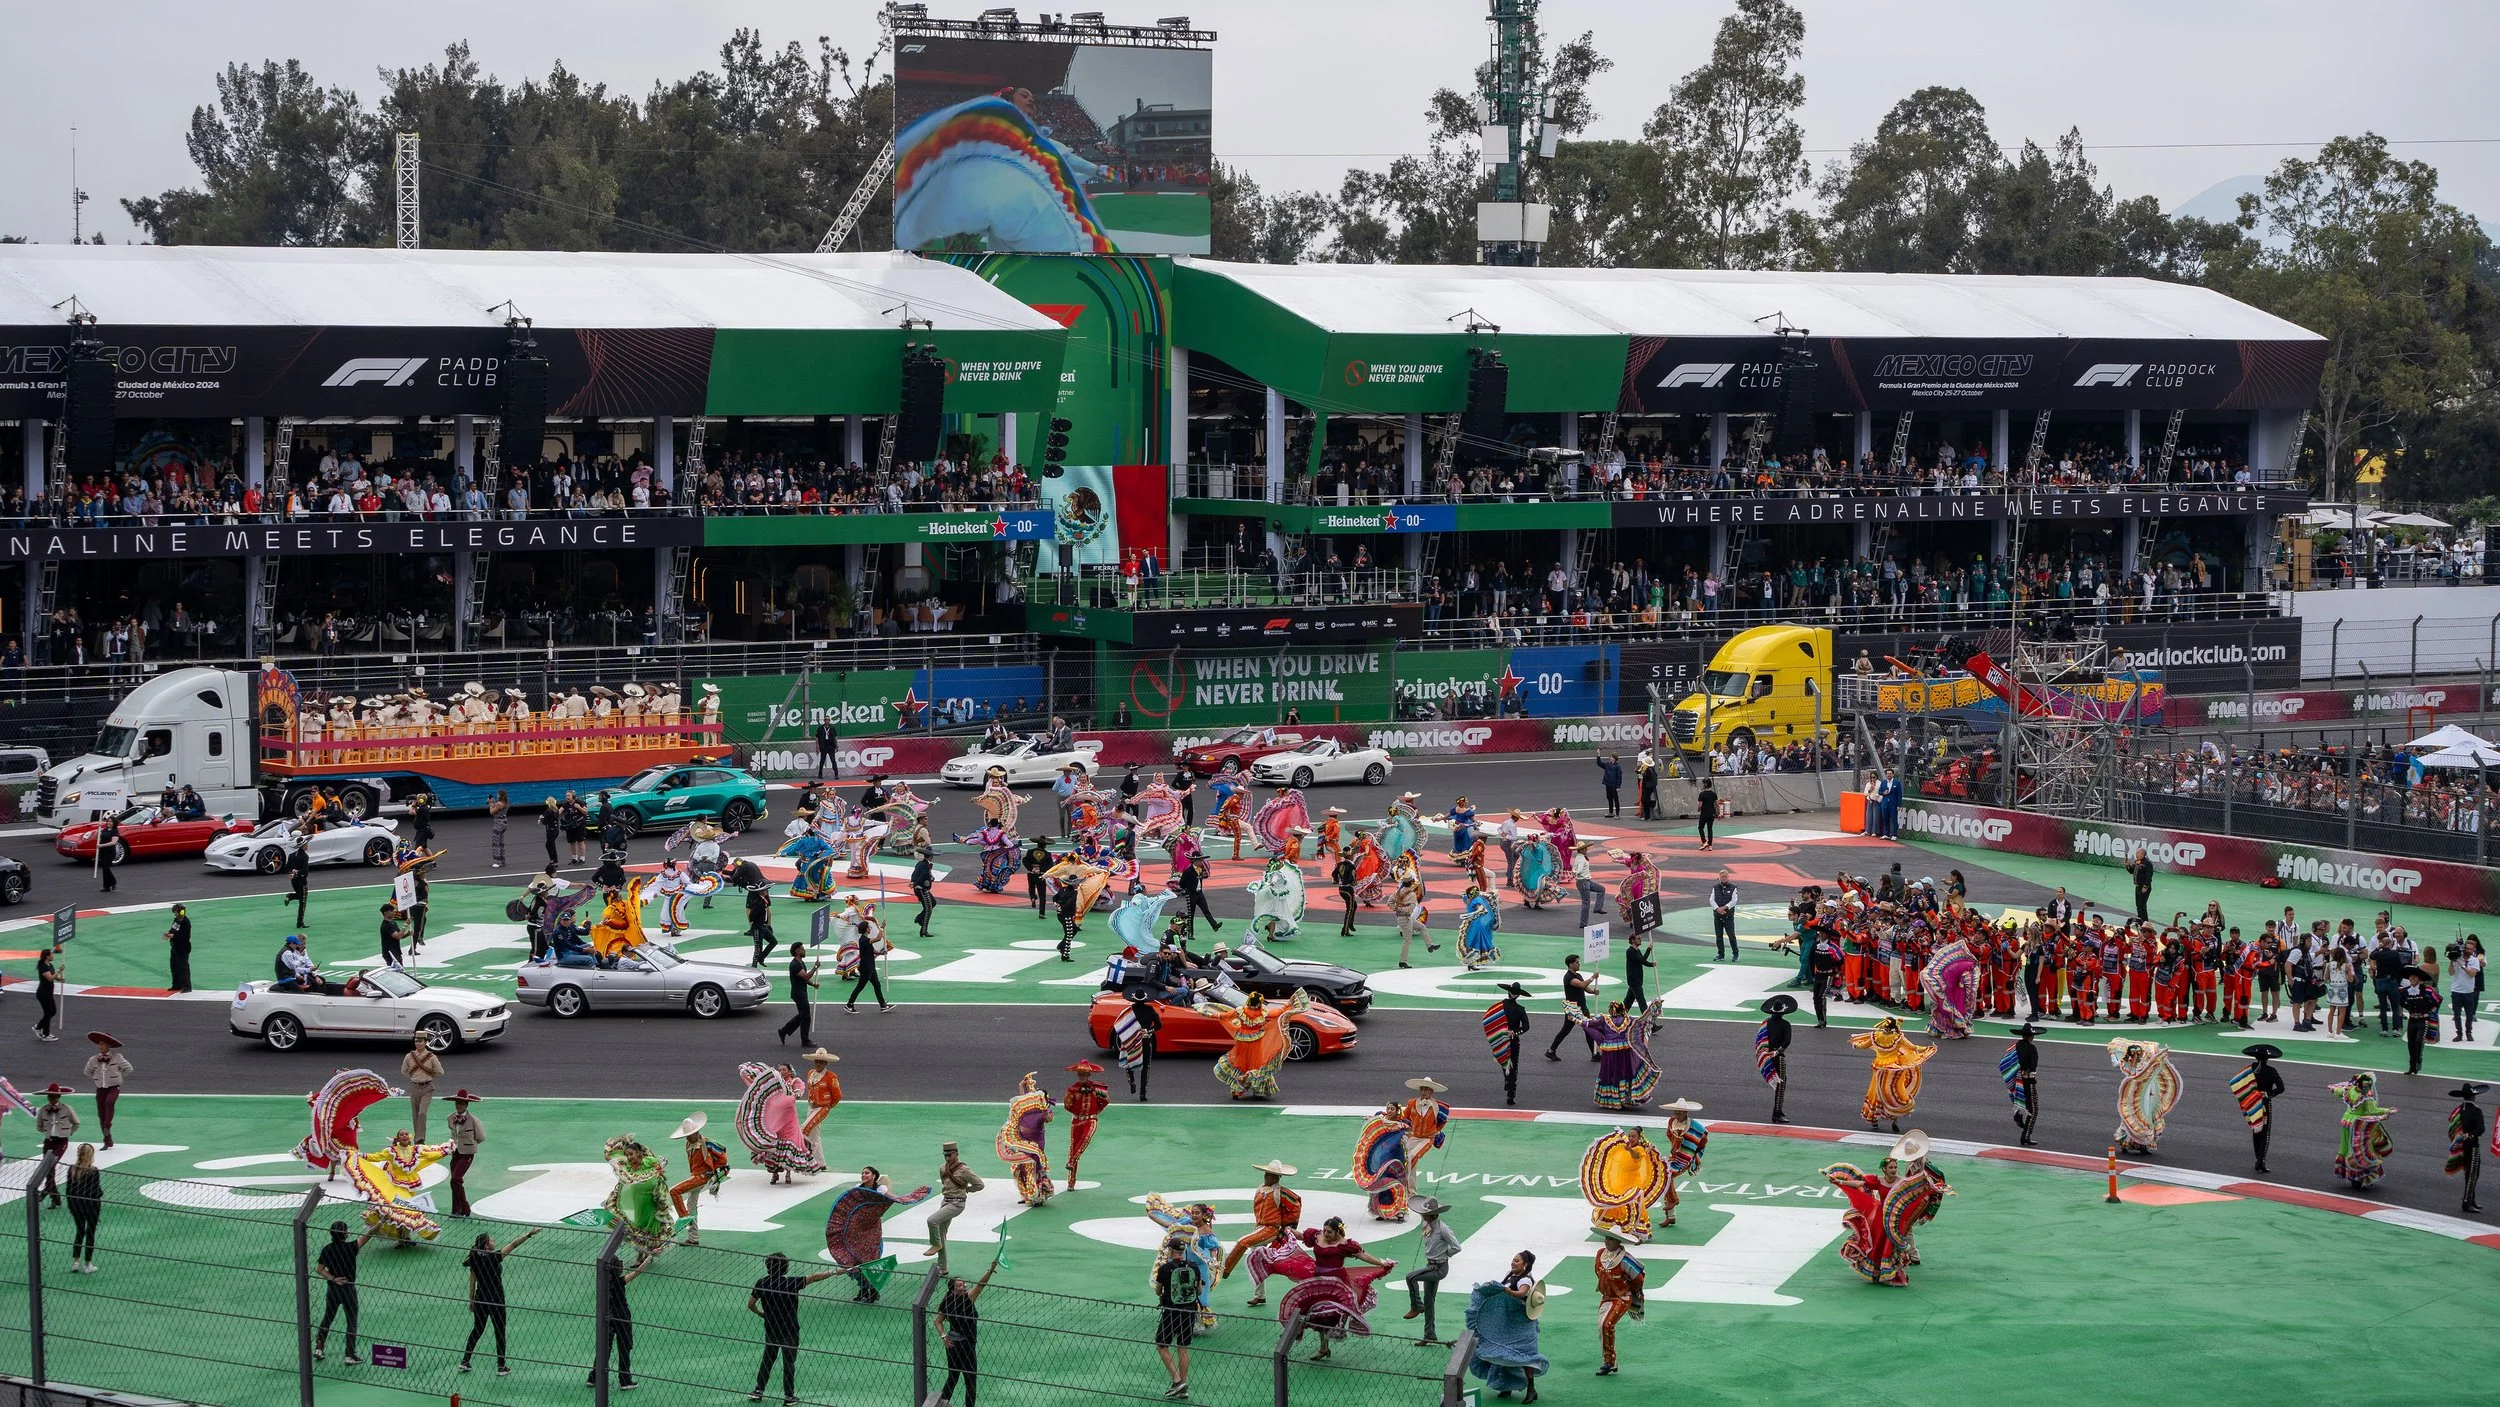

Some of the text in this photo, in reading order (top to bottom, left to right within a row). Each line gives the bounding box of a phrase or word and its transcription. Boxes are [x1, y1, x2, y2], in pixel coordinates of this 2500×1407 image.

[0, 346, 237, 374] MEXCO CITY
[439, 358, 499, 370] PADD
[961, 360, 1042, 372] WHEN YOU DRIVE
[1873, 355, 2033, 376] MEXICO CITY
[1370, 364, 1443, 374] WHEN YOU DRIVE
[1741, 363, 1783, 374] PADD
[2148, 364, 2216, 375] PADDOCK
[438, 374, 497, 386] CLUB
[959, 371, 1022, 382] NEVER DRINK
[1368, 374, 1425, 383] NEVER DRINK
[1740, 376, 1782, 387] CLUB
[2146, 376, 2184, 387] CLUB
[117, 380, 220, 389] Ciudad de México 2024
[1983, 381, 2003, 389] México
[1658, 495, 2266, 523] WHERE ADRENALINE MEETS ELEGANCE
[928, 522, 985, 536] Heineken
[1327, 515, 1380, 529] Heineken
[11, 525, 636, 556] NALINE MEETS ELEGANCE
[2125, 644, 2286, 667] paddockclub.com
[1195, 652, 1379, 680] WHEN YOU DRIVE
[1652, 665, 1687, 677] SEE
[1196, 680, 1339, 705] NEVER DRINK
[1395, 676, 1488, 700] Heineken
[768, 701, 886, 728] Heneken
[1367, 727, 1492, 749] #MexicoGP
[1553, 722, 1667, 744] #MexicoG
[1898, 806, 2012, 840] #MexicoGP
[2074, 829, 2206, 867] #MexicoGP
[2277, 853, 2422, 895] #MexicoGP
[1638, 901, 1655, 918] Stake
[1589, 940, 1607, 949] ALPINE
[1308, 1167, 1581, 1187] ANAMTE
